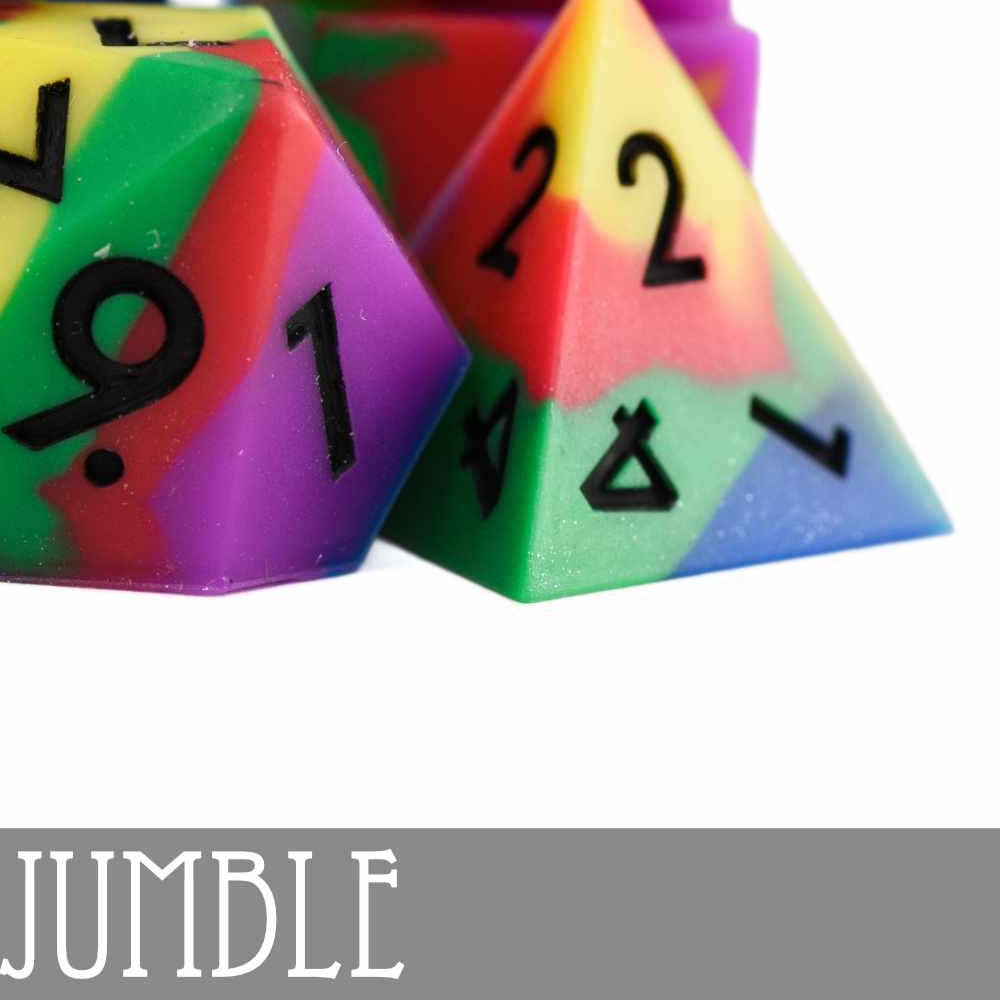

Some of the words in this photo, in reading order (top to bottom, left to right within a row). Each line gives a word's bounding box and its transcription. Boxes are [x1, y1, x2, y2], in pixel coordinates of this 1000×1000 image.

[475, 126, 558, 279] 2
[618, 130, 707, 288] 2
[285, 281, 357, 481] 1
[579, 397, 680, 512] 4
[749, 394, 852, 480] 1
